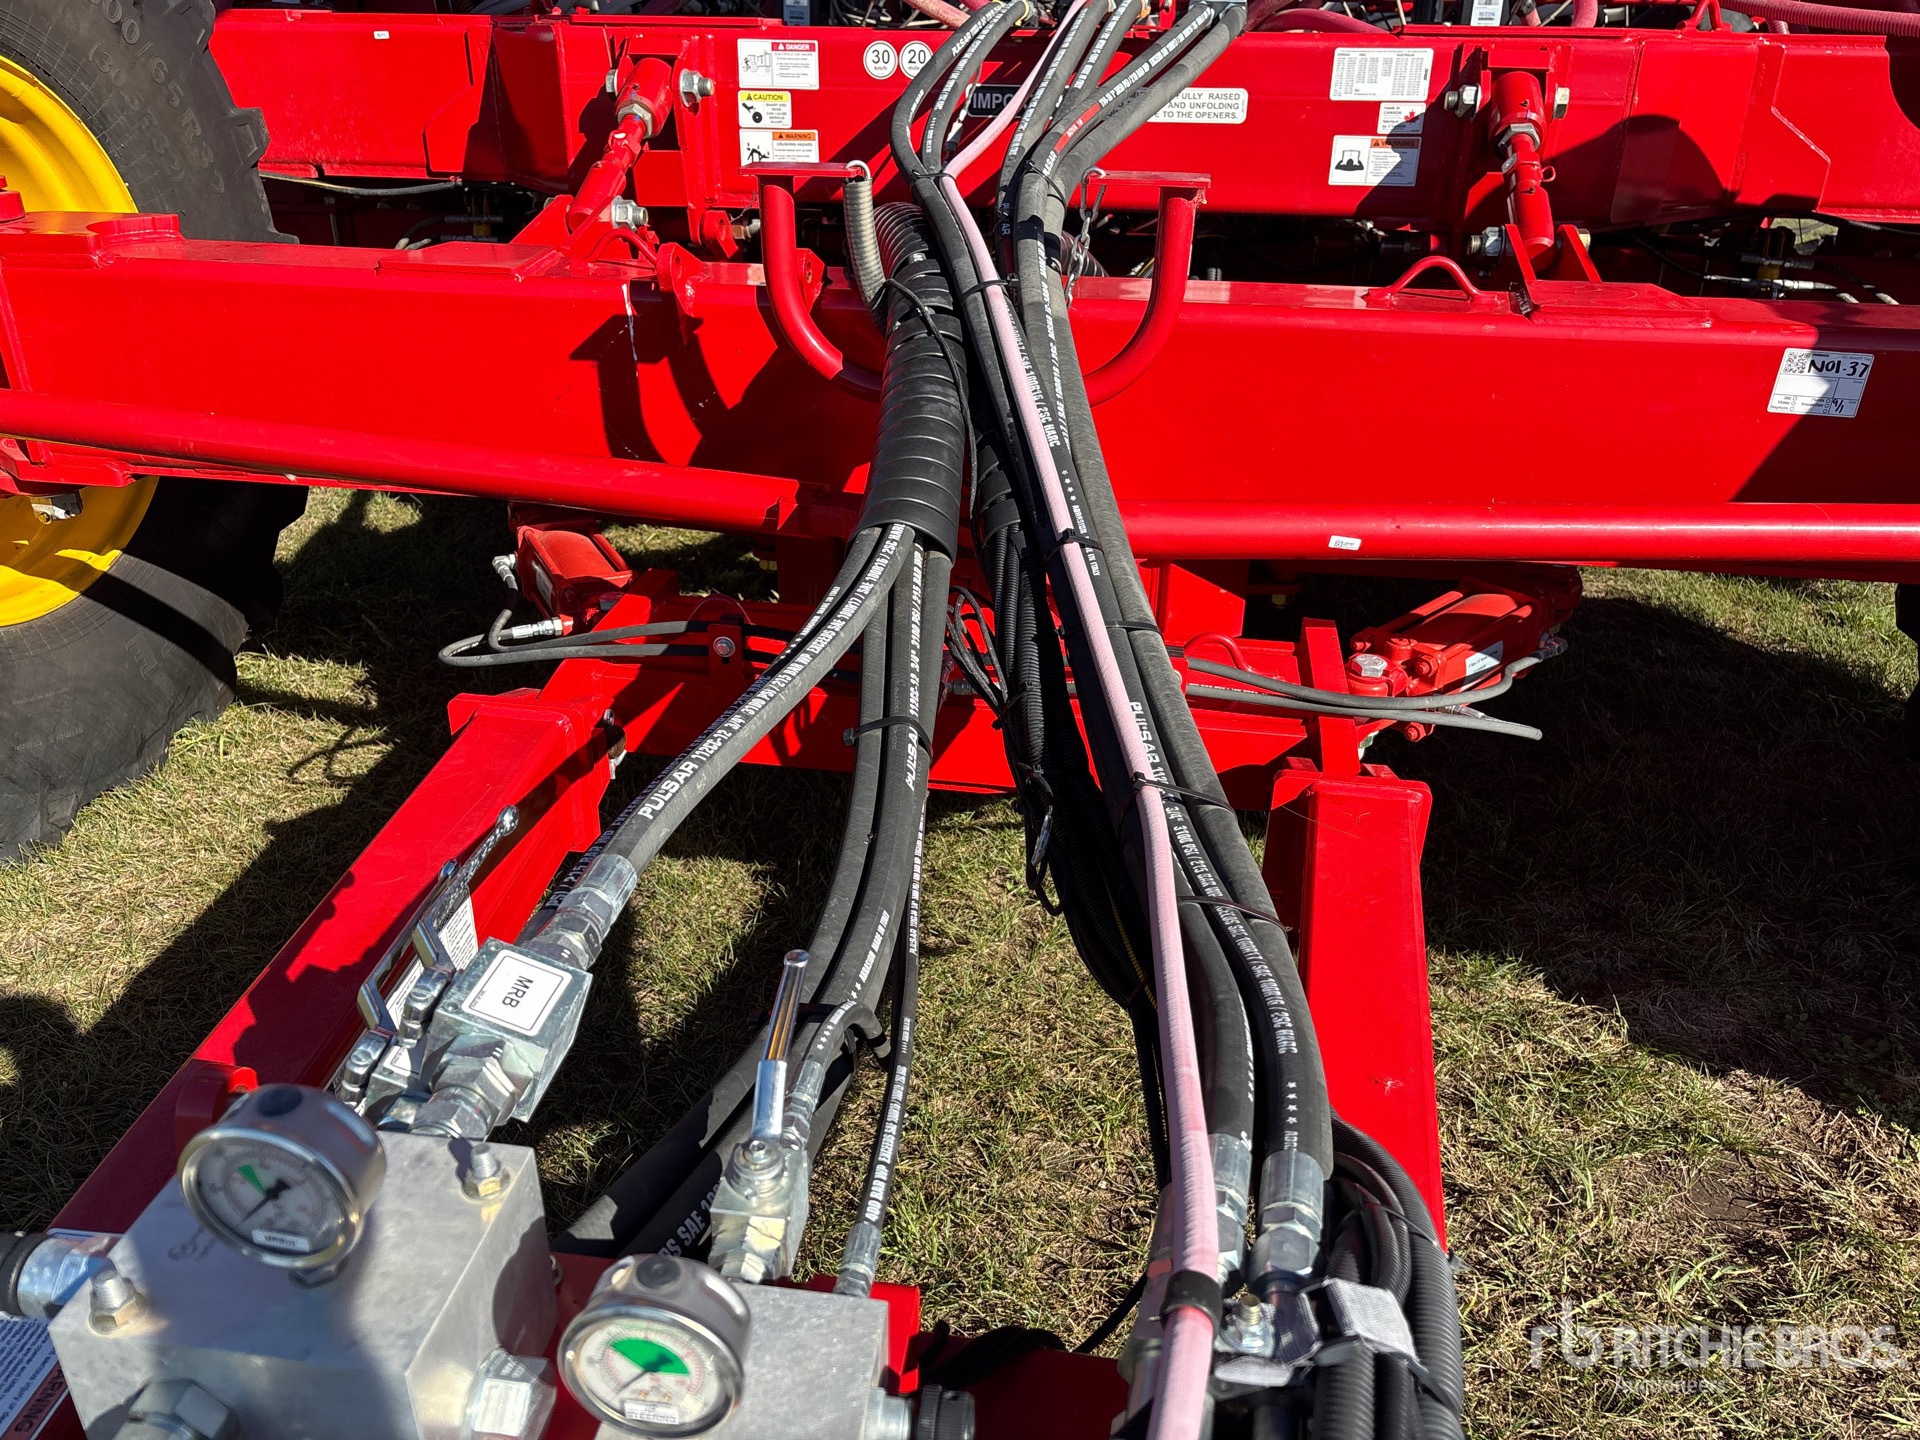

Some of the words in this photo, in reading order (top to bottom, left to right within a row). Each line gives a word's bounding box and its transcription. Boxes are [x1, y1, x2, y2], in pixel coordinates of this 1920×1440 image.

[871, 49, 890, 64] 30
[907, 49, 927, 64] 20
[972, 92, 1014, 110] IMPO
[1167, 101, 1186, 109] AND
[1189, 101, 1240, 110] UNFOLDING
[1208, 92, 1241, 100] RAISED
[1162, 110, 1174, 118] TO
[1195, 111, 1239, 119] OPENERS.
[1038, 406, 1052, 426] 2SC
[1043, 421, 1061, 449] HARC
[637, 761, 699, 820] PULSAR
[691, 729, 733, 761] 112CC-12
[740, 698, 767, 716] 3100
[756, 687, 778, 702] PSI
[771, 673, 793, 688] 215
[782, 662, 805, 677] BAR
[794, 653, 814, 666] WP
[806, 629, 837, 655] EXCEEDS
[827, 618, 847, 632] SAE
[837, 597, 863, 620] 100R17
[857, 581, 875, 596] SAE
[881, 540, 898, 555] 2SC
[1130, 701, 1160, 764] PULSAR
[905, 726, 919, 791] PULSA
[1173, 825, 1189, 844] 3100
[1181, 840, 1199, 857] PSI
[909, 928, 919, 957] PULSAR
[502, 975, 534, 1008] MRB
[1271, 1012, 1293, 1028] 2SC
[1275, 1027, 1298, 1055] HARC
[878, 1133, 896, 1166] EXCEEDS
[874, 1164, 889, 1182] WP
[869, 1181, 886, 1202] BAR
[676, 1209, 706, 1248] SAE
[14, 1369, 64, 1432] ARNING
